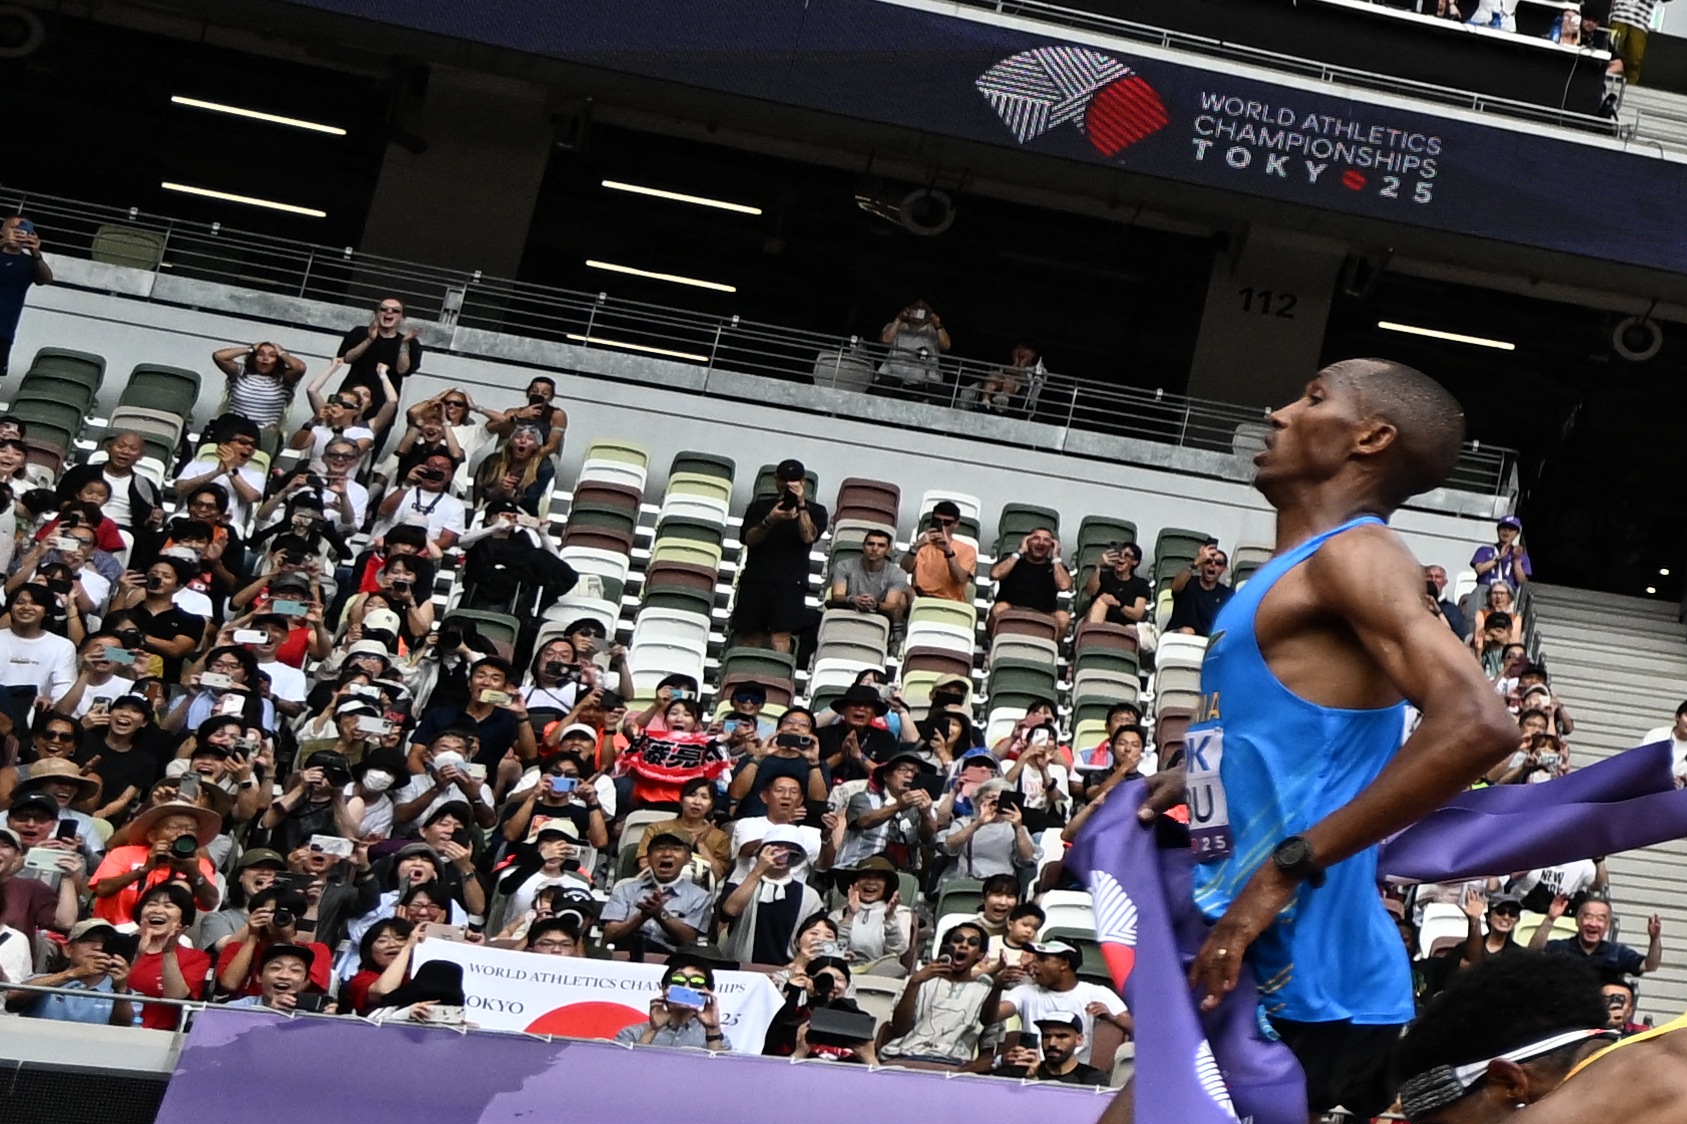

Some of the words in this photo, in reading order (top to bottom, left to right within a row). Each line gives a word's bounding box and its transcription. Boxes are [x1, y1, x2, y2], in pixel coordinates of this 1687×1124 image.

[1201, 91, 1296, 126] WORLD
[1302, 113, 1442, 156] ATHLETICS
[1194, 114, 1438, 179] CHAMPIONSHIPS
[1239, 287, 1298, 319] 112
[470, 962, 527, 981] WORLD
[530, 972, 617, 990] ATHLETICS
[465, 994, 525, 1016] OKYO
